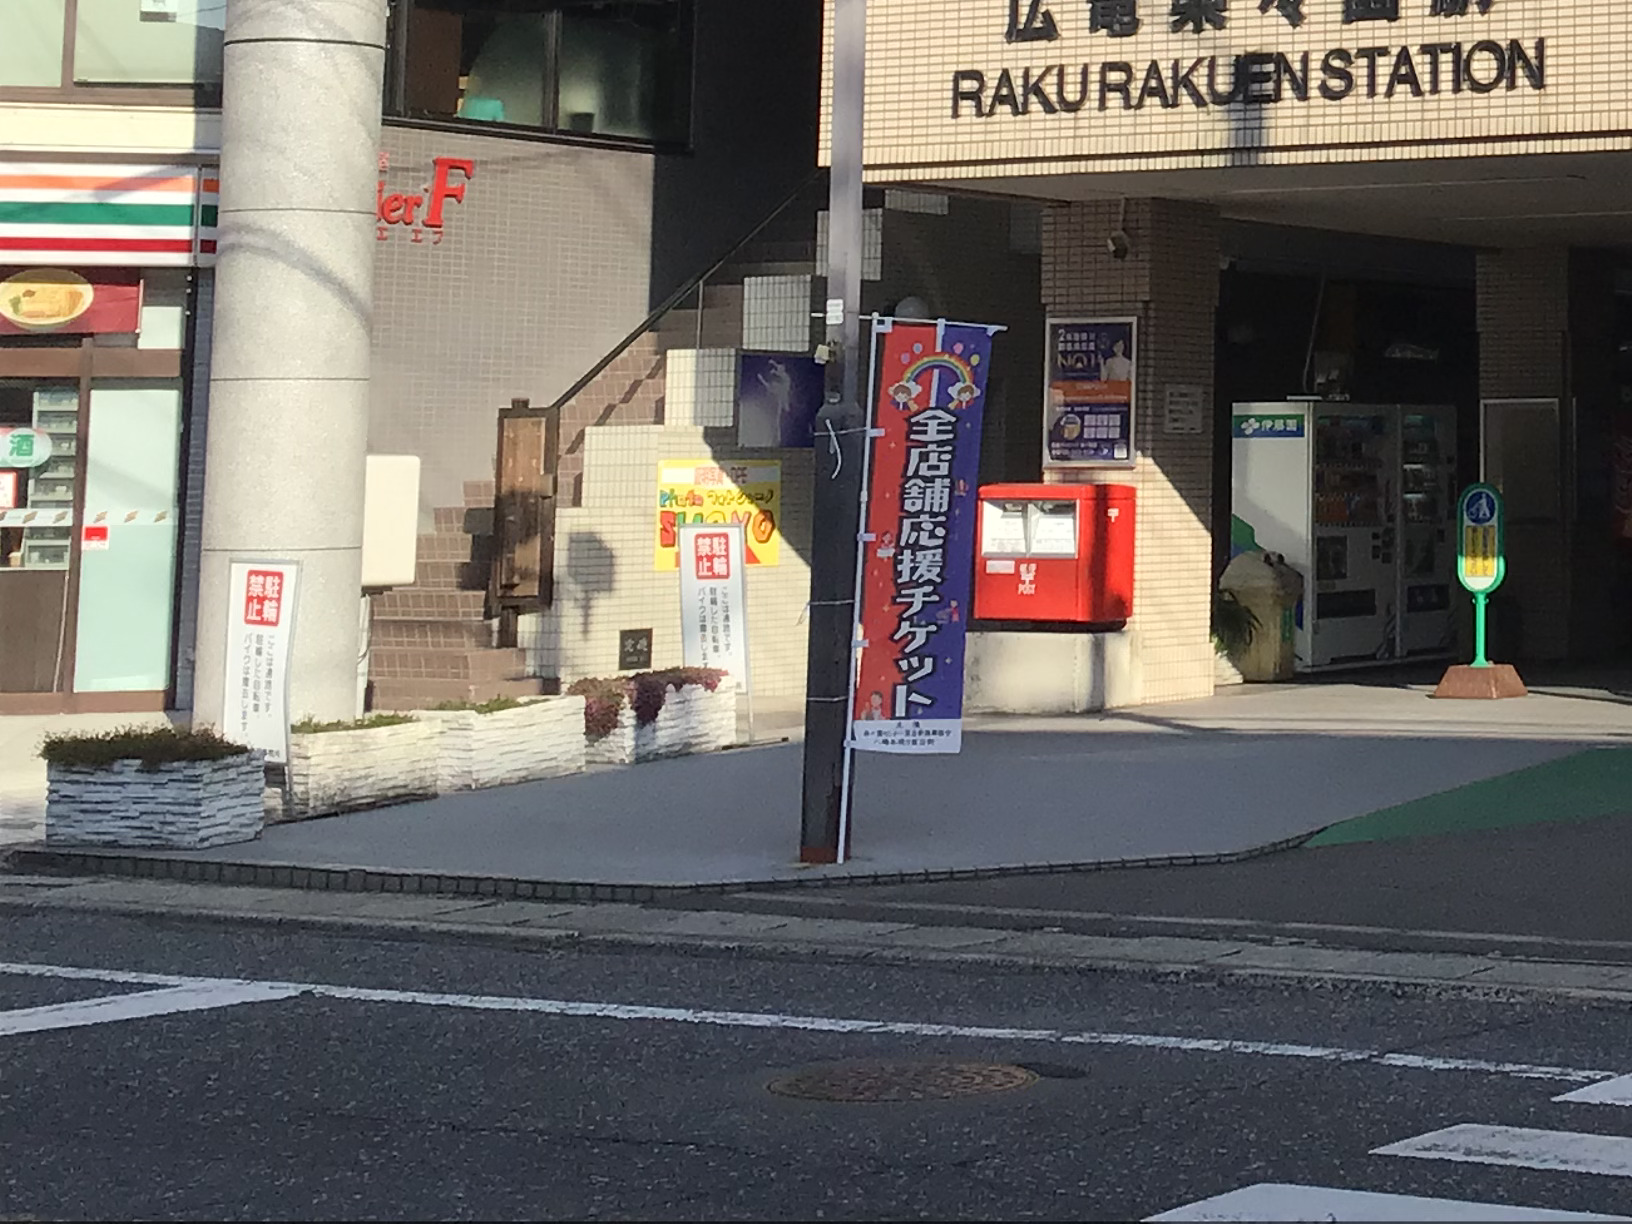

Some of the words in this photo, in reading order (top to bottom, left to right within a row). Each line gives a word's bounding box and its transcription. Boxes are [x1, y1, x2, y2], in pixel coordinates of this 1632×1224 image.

[1318, 38, 1547, 103] STATION
[9, 433, 35, 457] 酒
[893, 407, 957, 718] 全店舗応援チケット
